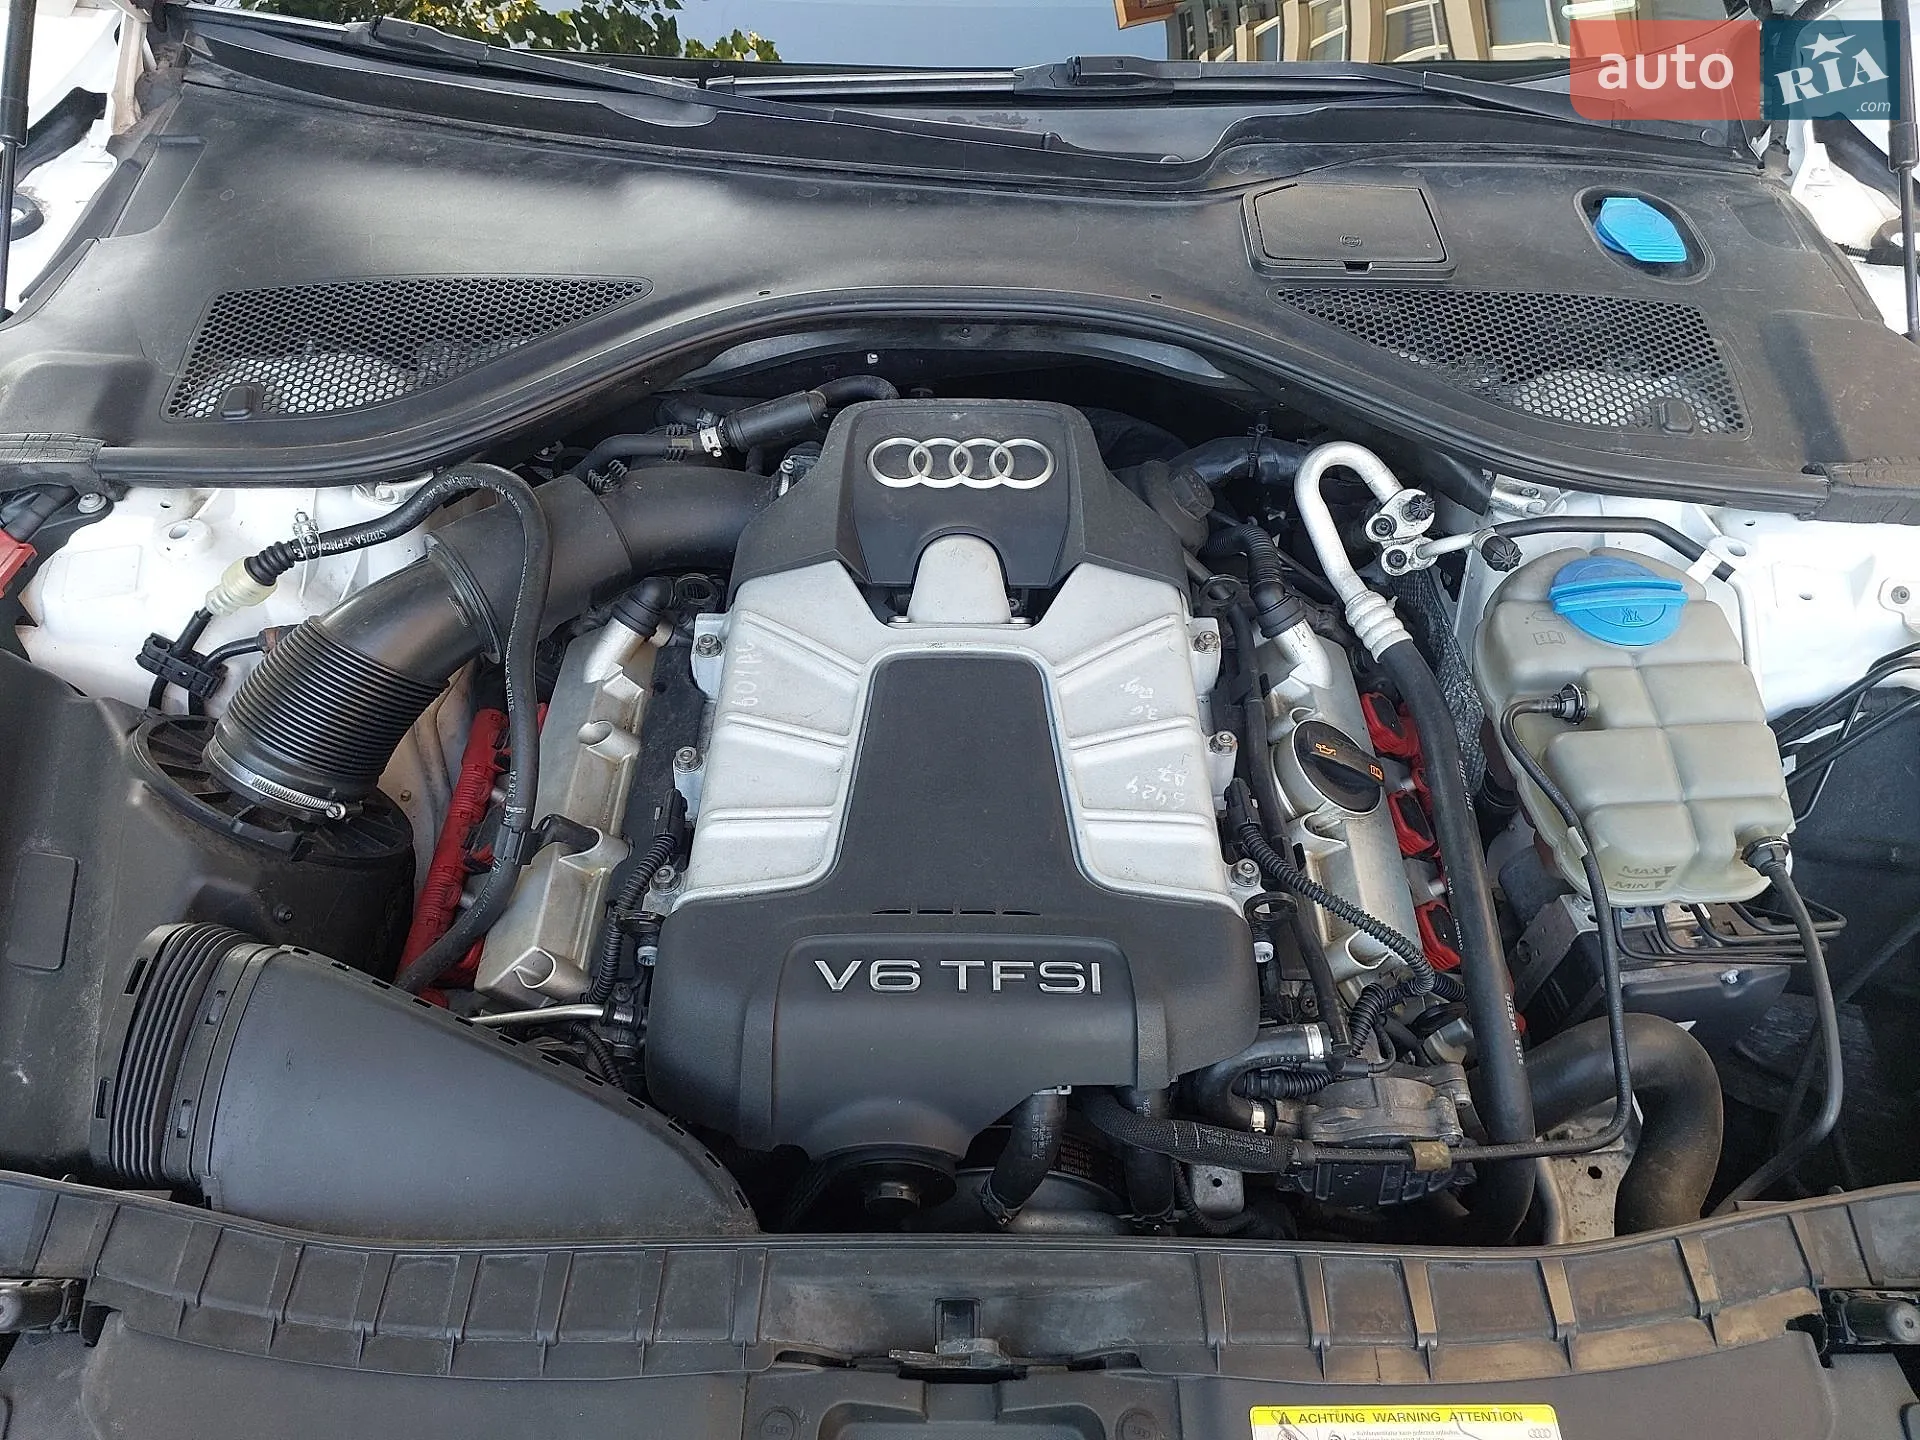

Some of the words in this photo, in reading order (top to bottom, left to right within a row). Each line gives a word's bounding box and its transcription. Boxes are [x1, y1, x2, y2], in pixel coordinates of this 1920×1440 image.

[1621, 865, 1661, 875] MAX
[1613, 879, 1649, 889] MIN
[814, 959, 922, 993] V6
[940, 960, 1101, 994] TFSI
[1298, 1412, 1365, 1424] ACHTUNG
[1372, 1411, 1441, 1423] WARNING
[1449, 1411, 1524, 1422] ATTENTION
